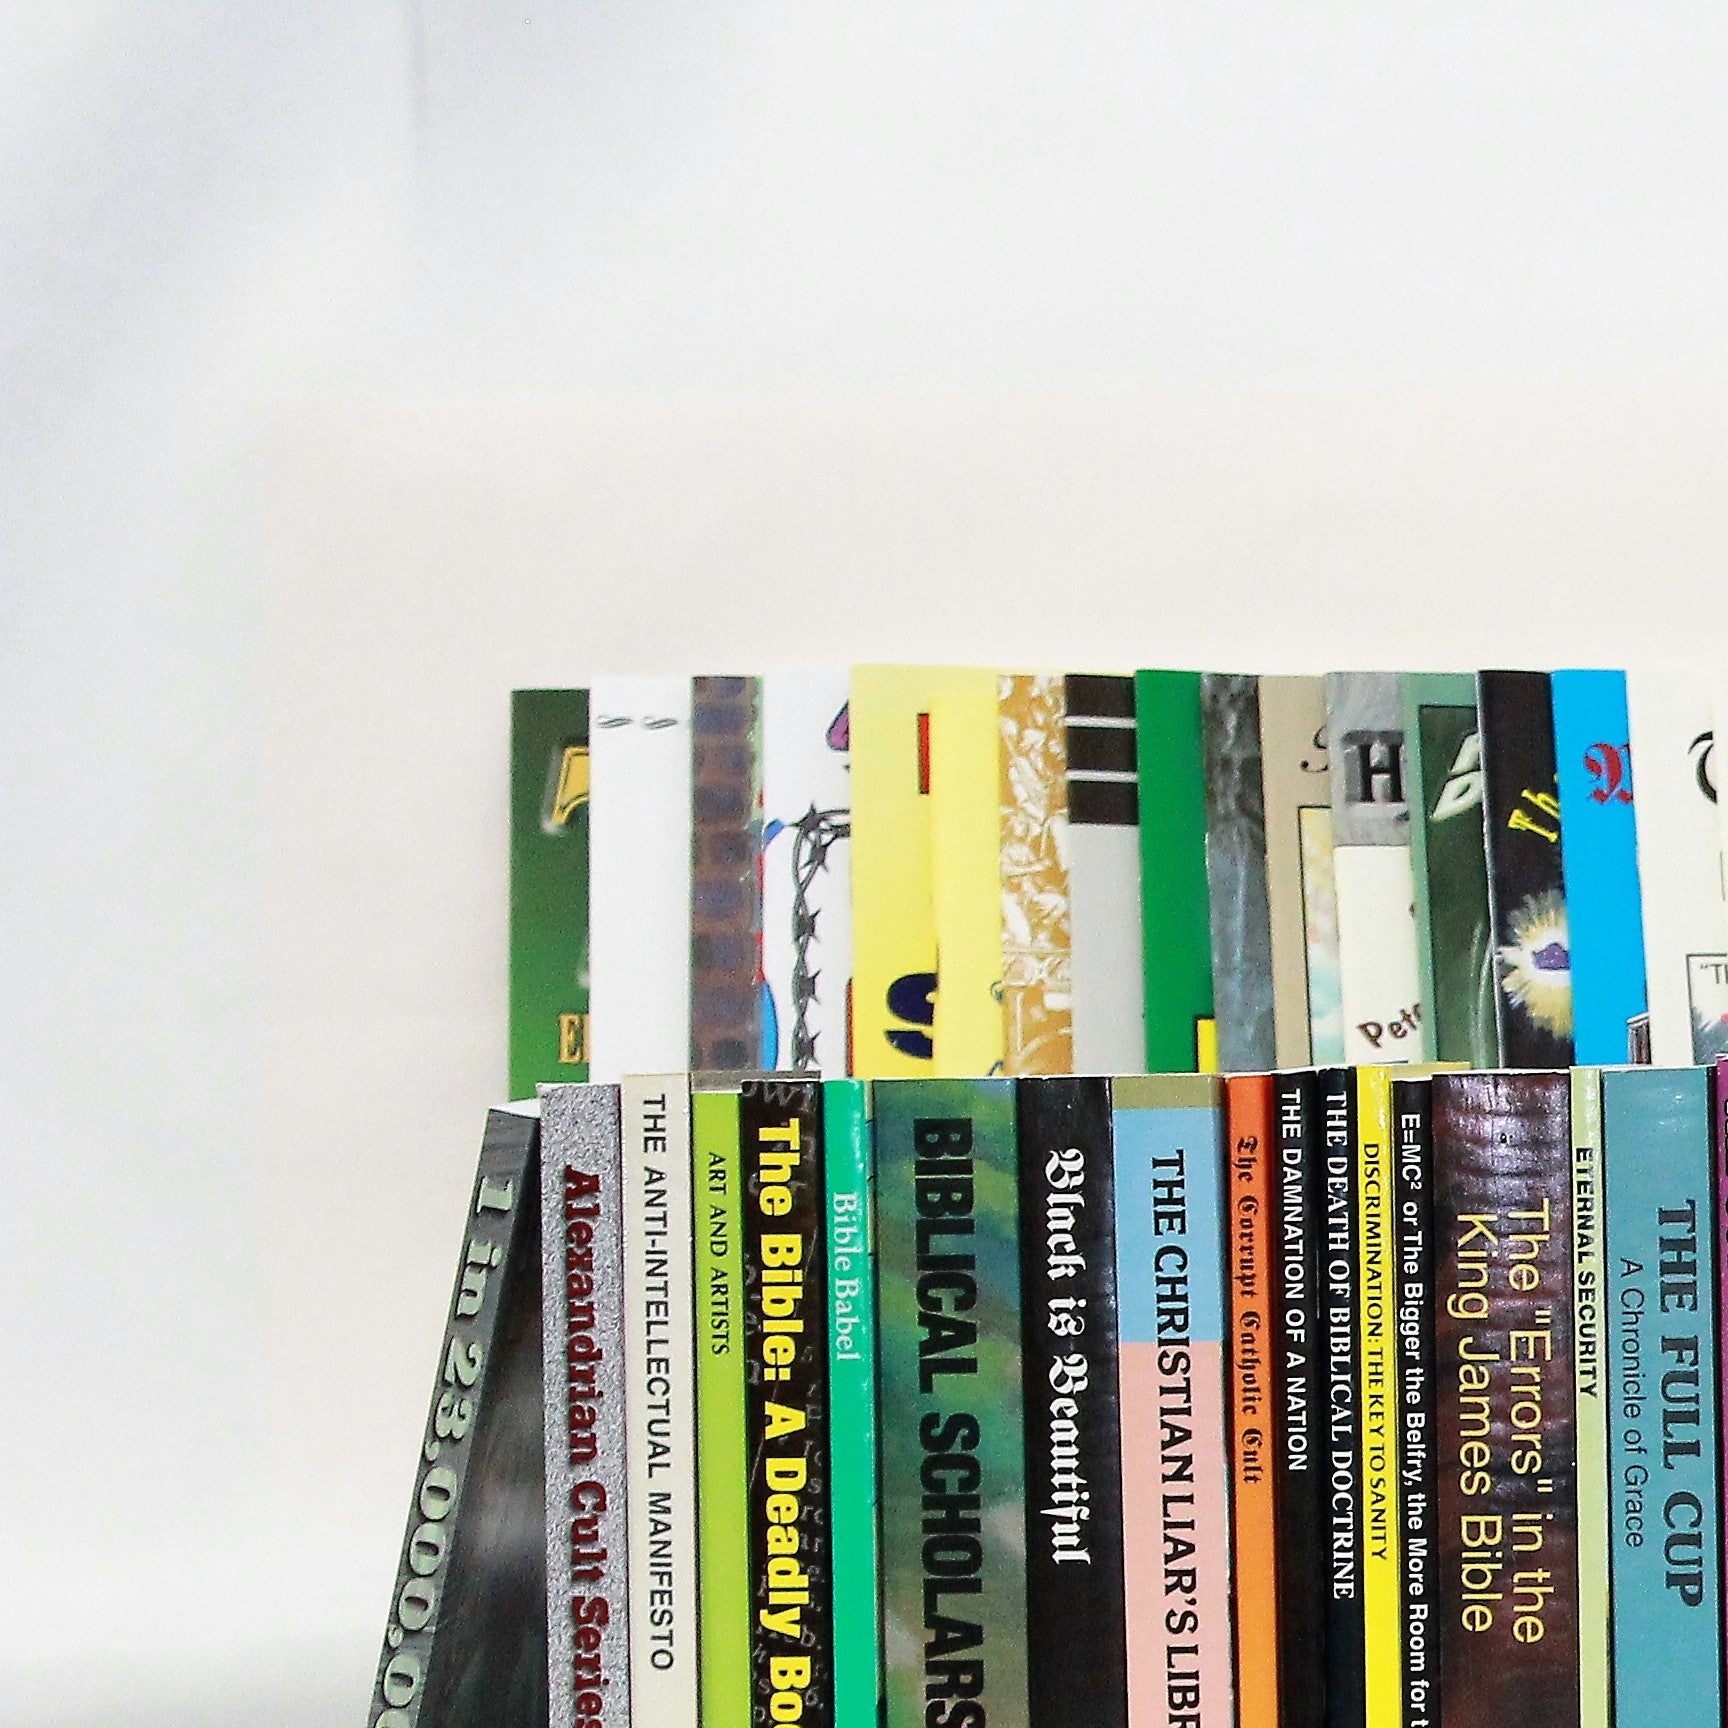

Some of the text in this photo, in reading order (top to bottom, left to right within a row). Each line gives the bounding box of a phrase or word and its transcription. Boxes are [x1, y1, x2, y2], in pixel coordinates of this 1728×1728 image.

[475, 1179, 513, 1214] 1
[757, 1118, 800, 1218] The
[1152, 1149, 1186, 1237] THE
[451, 1242, 502, 1318] in
[564, 1164, 608, 1464] Alexandrian
[707, 1152, 730, 1354] ART AND ARTISTS
[760, 1234, 805, 1383] Bible:
[913, 1117, 981, 1395] BIBLICAL
[1575, 1147, 1599, 1398] ETERNAL SECURITY
[643, 1094, 674, 1671] THE ANTI-INTELLECTUAL MANIFESTO
[764, 1401, 807, 1440] A
[1153, 1245, 1195, 1484] CHRISTIAN
[1620, 1257, 1649, 1548] A Chronicle of Grace
[569, 1481, 608, 1585] Cult
[762, 1457, 812, 1639] Deadly
[1160, 1501, 1199, 1634] LIAR'S
